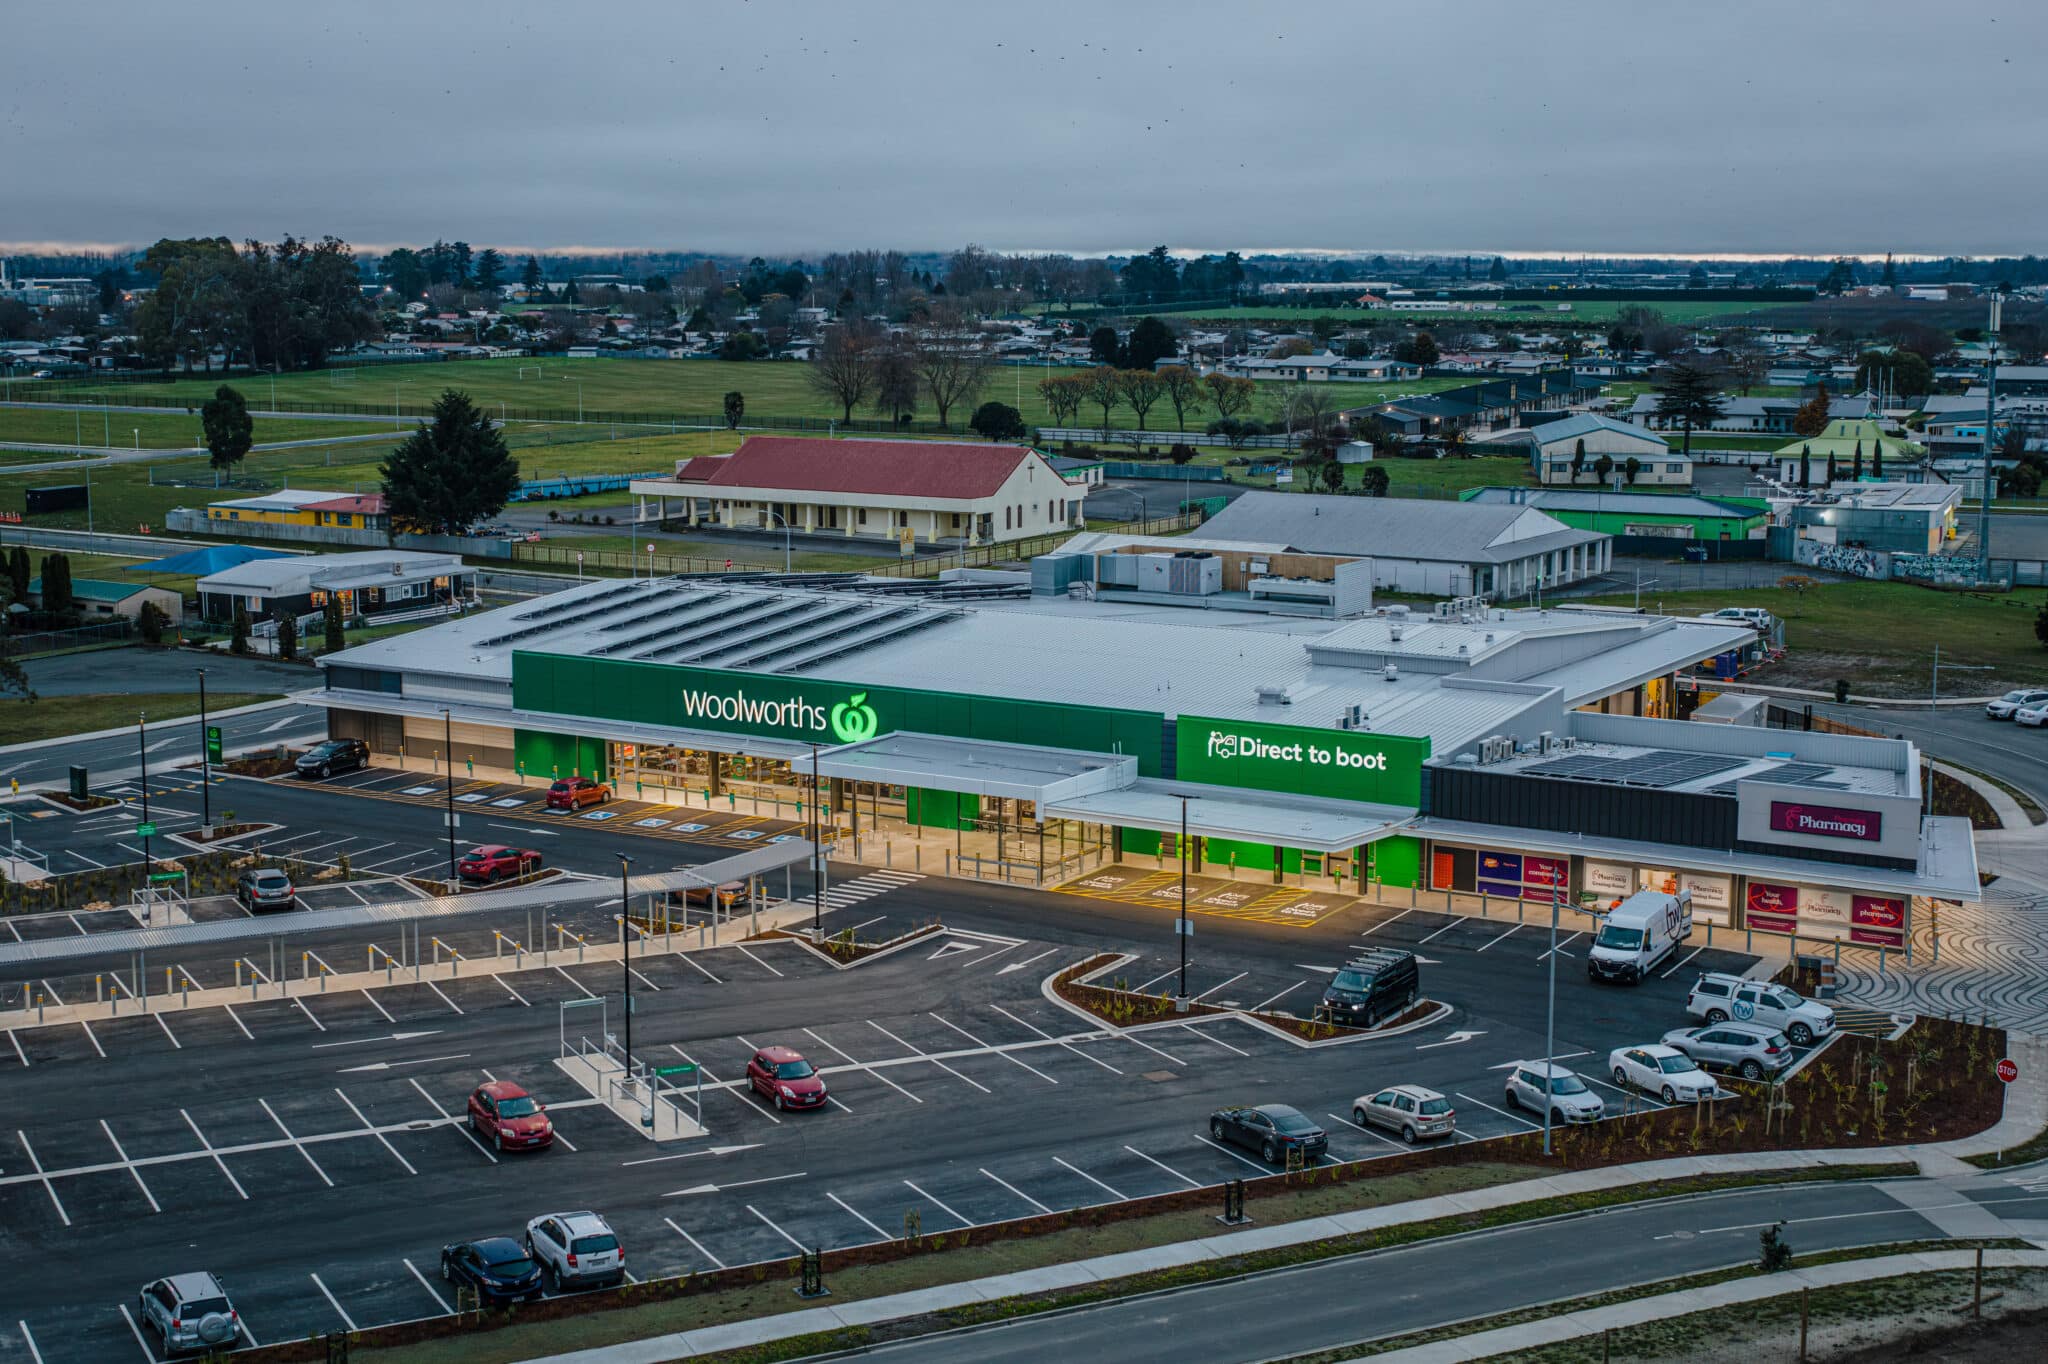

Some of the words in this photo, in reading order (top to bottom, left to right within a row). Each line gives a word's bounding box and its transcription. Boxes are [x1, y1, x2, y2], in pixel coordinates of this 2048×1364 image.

[682, 689, 827, 731] Woolworths
[1240, 736, 1303, 762] Direct
[1308, 744, 1332, 765] to
[1336, 746, 1387, 771] boot
[1799, 815, 1866, 836] Pharmacy
[1870, 903, 1886, 911] Your
[1735, 1005, 1751, 1015] TW
[1999, 1065, 2016, 1076] STOP
